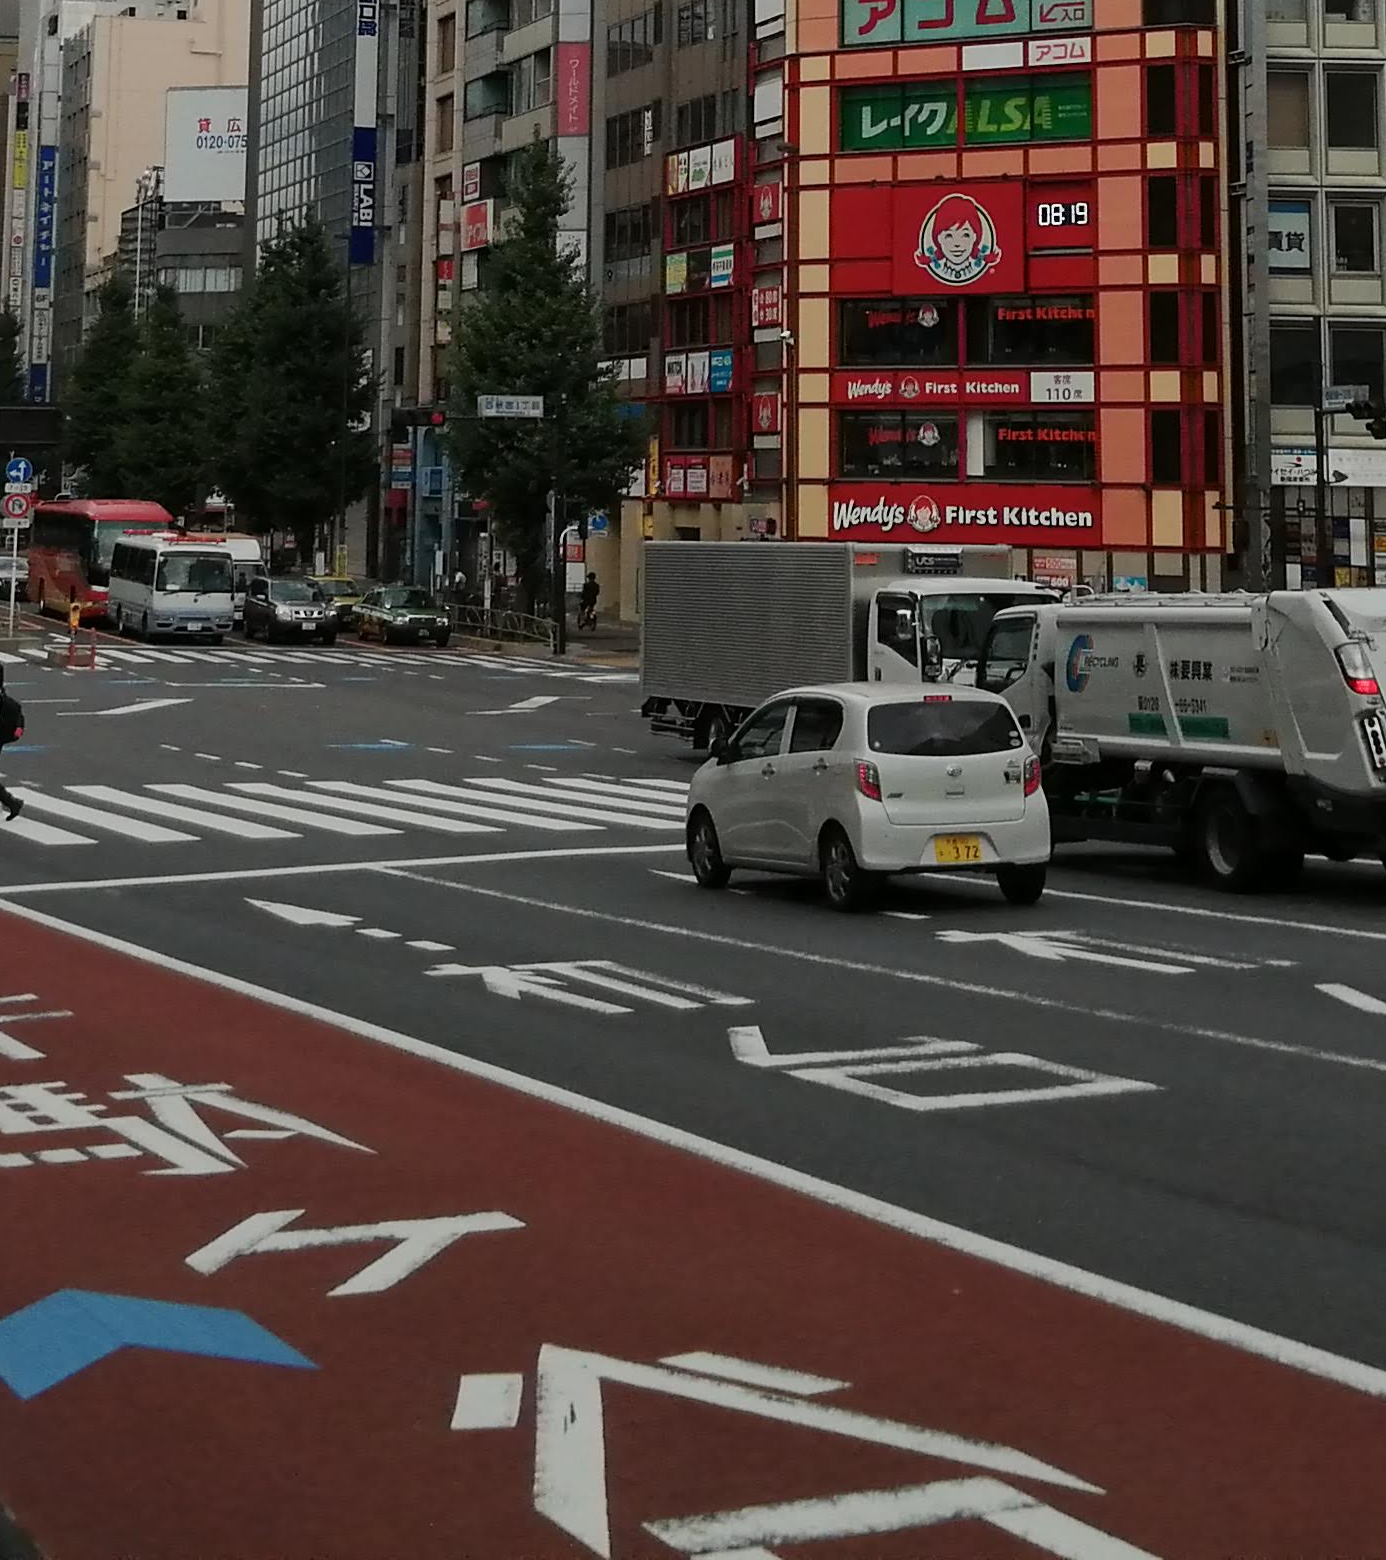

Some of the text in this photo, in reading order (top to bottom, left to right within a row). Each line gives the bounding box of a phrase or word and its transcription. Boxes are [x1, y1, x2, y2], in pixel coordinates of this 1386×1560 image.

[1060, 6, 1086, 24] 入口
[1035, 42, 1086, 63] アコム
[860, 101, 949, 139] レイク
[360, 183, 374, 228] LABI
[1037, 201, 1088, 226] 08:19
[997, 307, 1033, 322] First
[847, 378, 1021, 400] Wendy's First Kitchen
[998, 427, 1034, 442] First
[832, 496, 1094, 532] Wendy's First Kitchen
